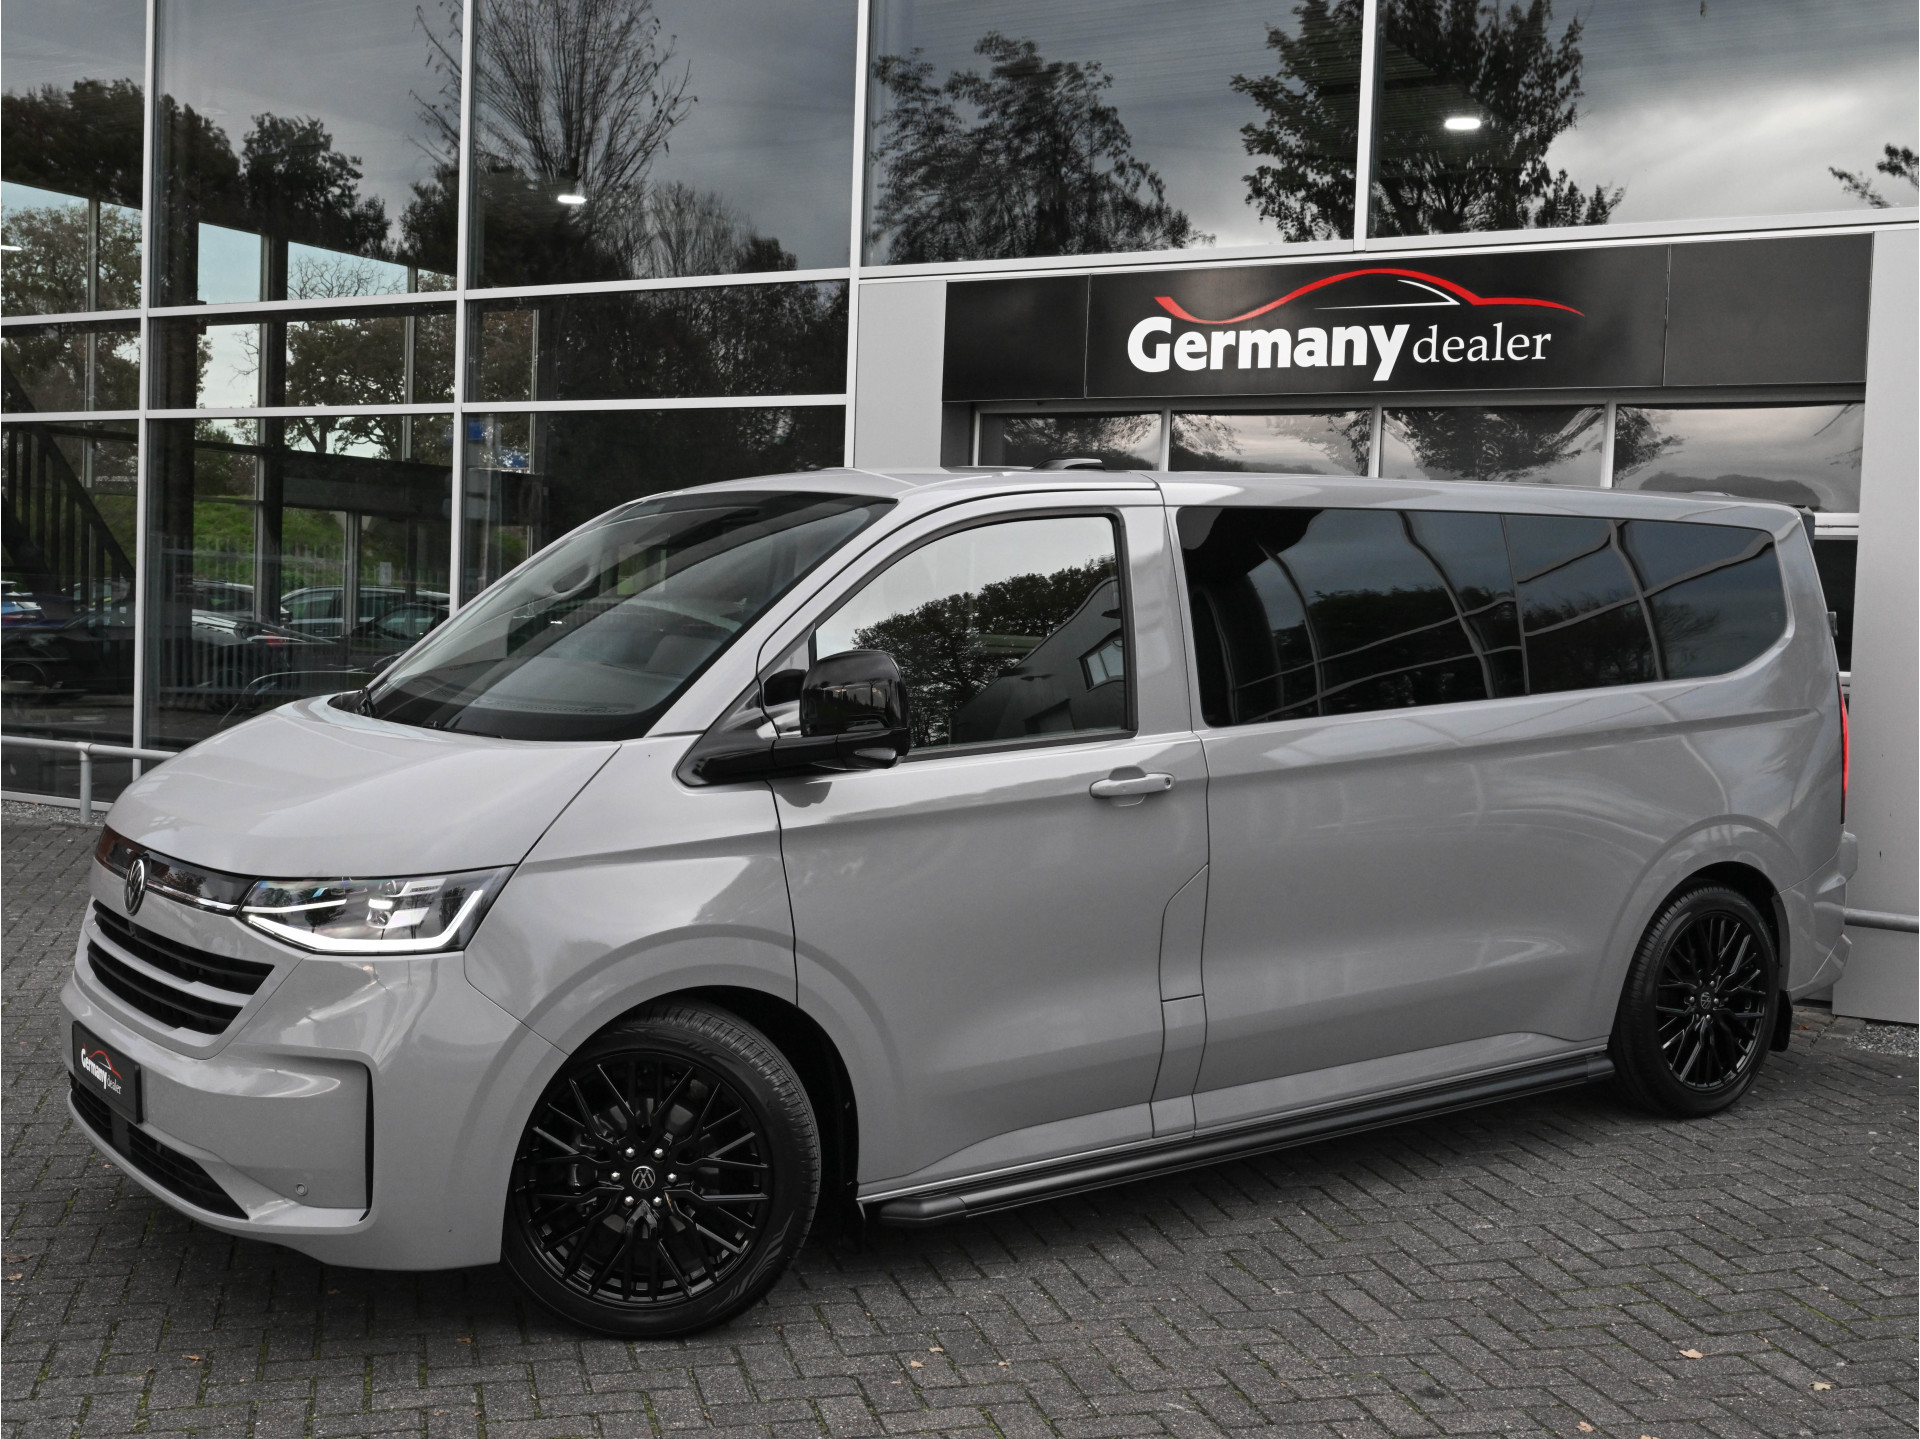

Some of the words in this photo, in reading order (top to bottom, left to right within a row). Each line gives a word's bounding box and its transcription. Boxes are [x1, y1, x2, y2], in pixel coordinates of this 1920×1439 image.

[1127, 316, 1410, 381] Germany
[1412, 322, 1552, 364] dealer
[81, 1048, 108, 1090] Germany
